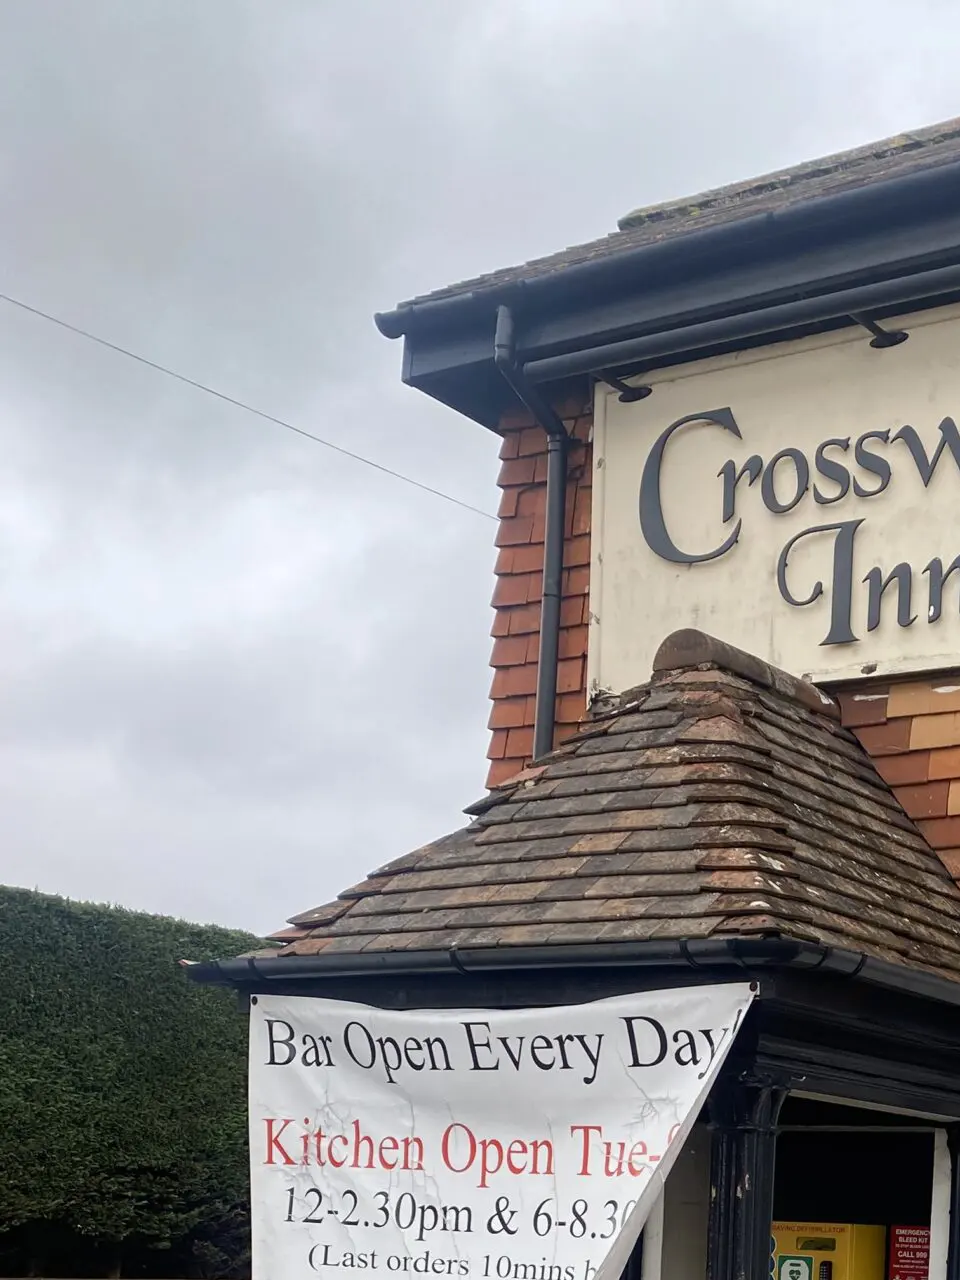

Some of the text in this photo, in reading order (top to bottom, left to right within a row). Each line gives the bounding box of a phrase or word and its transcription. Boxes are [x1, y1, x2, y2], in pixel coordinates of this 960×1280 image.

[264, 1019, 336, 1067] Bar
[343, 1021, 455, 1084] Open
[460, 1021, 605, 1085] Every
[262, 1117, 425, 1171] Kitchen
[441, 1123, 554, 1188] Open
[284, 1186, 473, 1242] 12-2.30pm
[486, 1196, 519, 1235] &
[308, 1243, 378, 1272] (Last
[386, 1253, 470, 1276] orders
